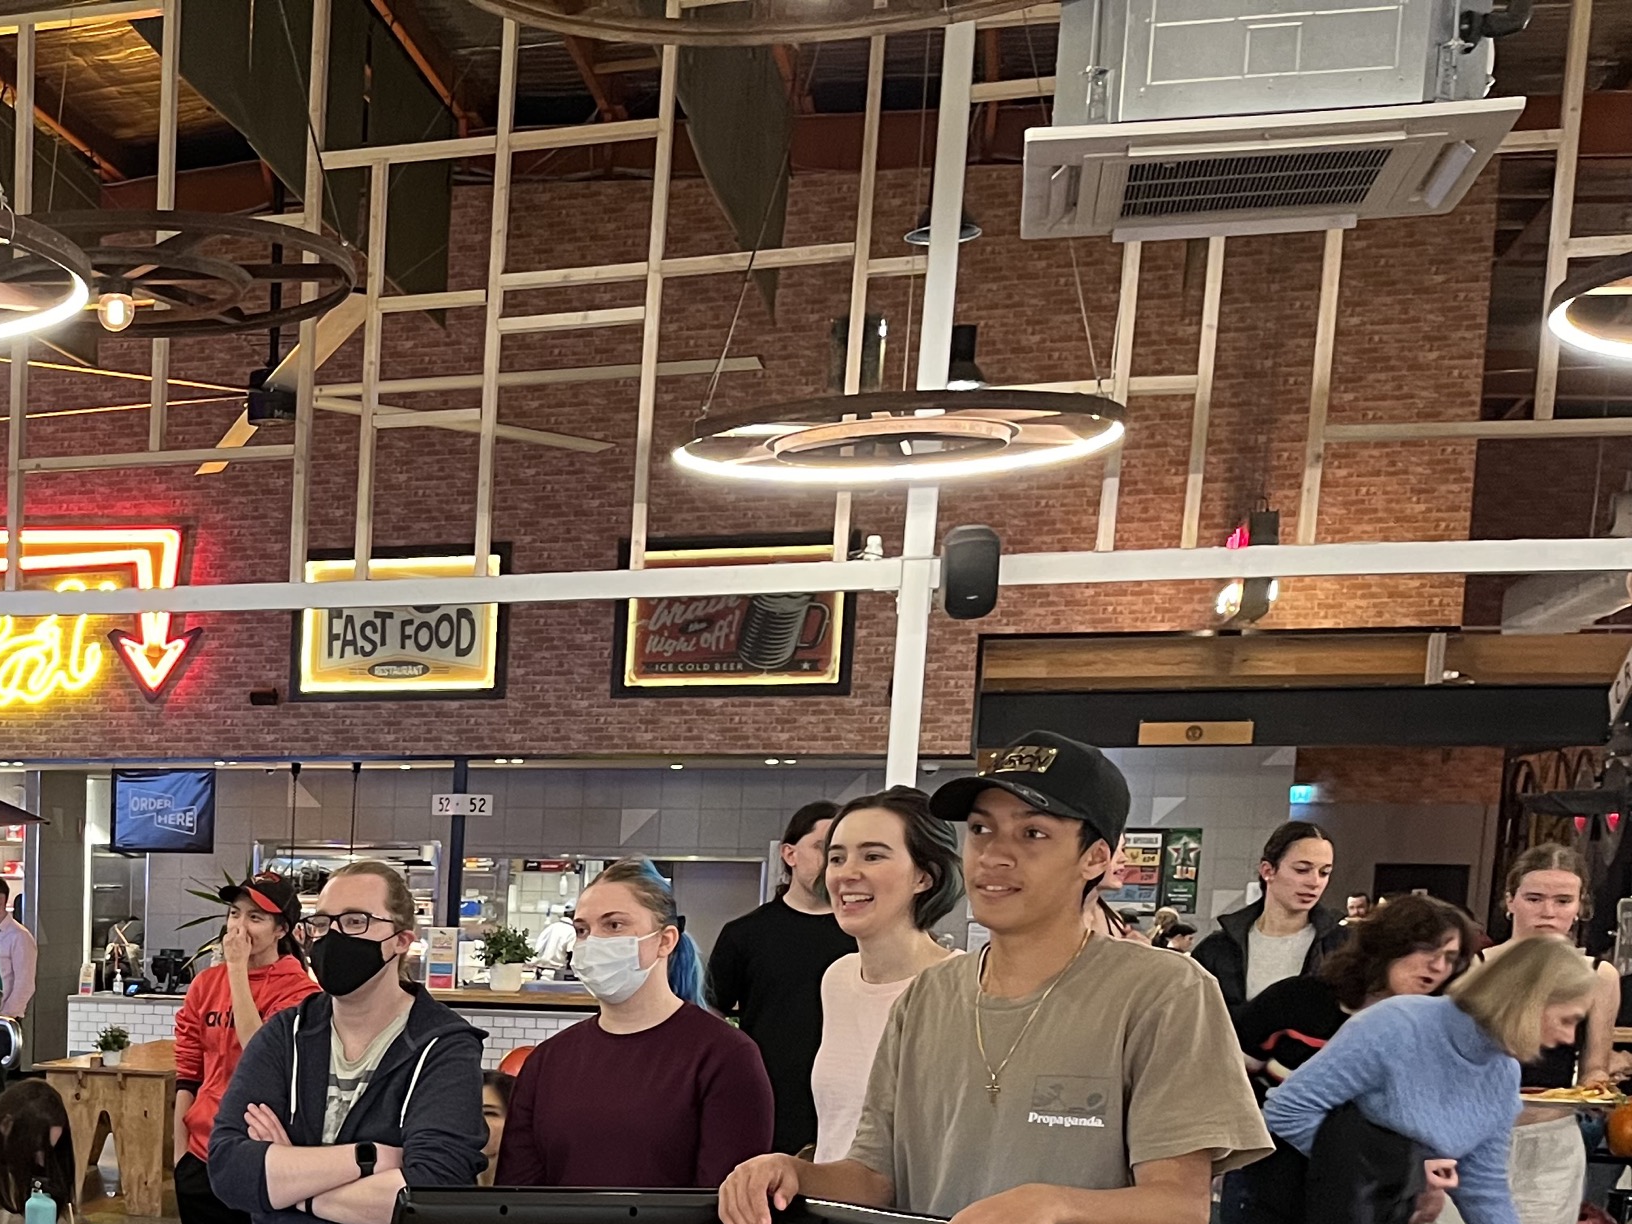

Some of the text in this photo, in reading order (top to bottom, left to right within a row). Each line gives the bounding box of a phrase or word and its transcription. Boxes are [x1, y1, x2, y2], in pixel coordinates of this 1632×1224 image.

[328, 608, 476, 660] FAST FOOD
[645, 609, 741, 658] Night off!
[374, 665, 424, 676] RESTAURANT
[655, 662, 744, 672] ICE COLD BEER
[131, 797, 172, 812] ORDER
[438, 797, 486, 813] 52 52
[158, 812, 194, 827] HERE
[1028, 1112, 1105, 1127] Propaganda.
